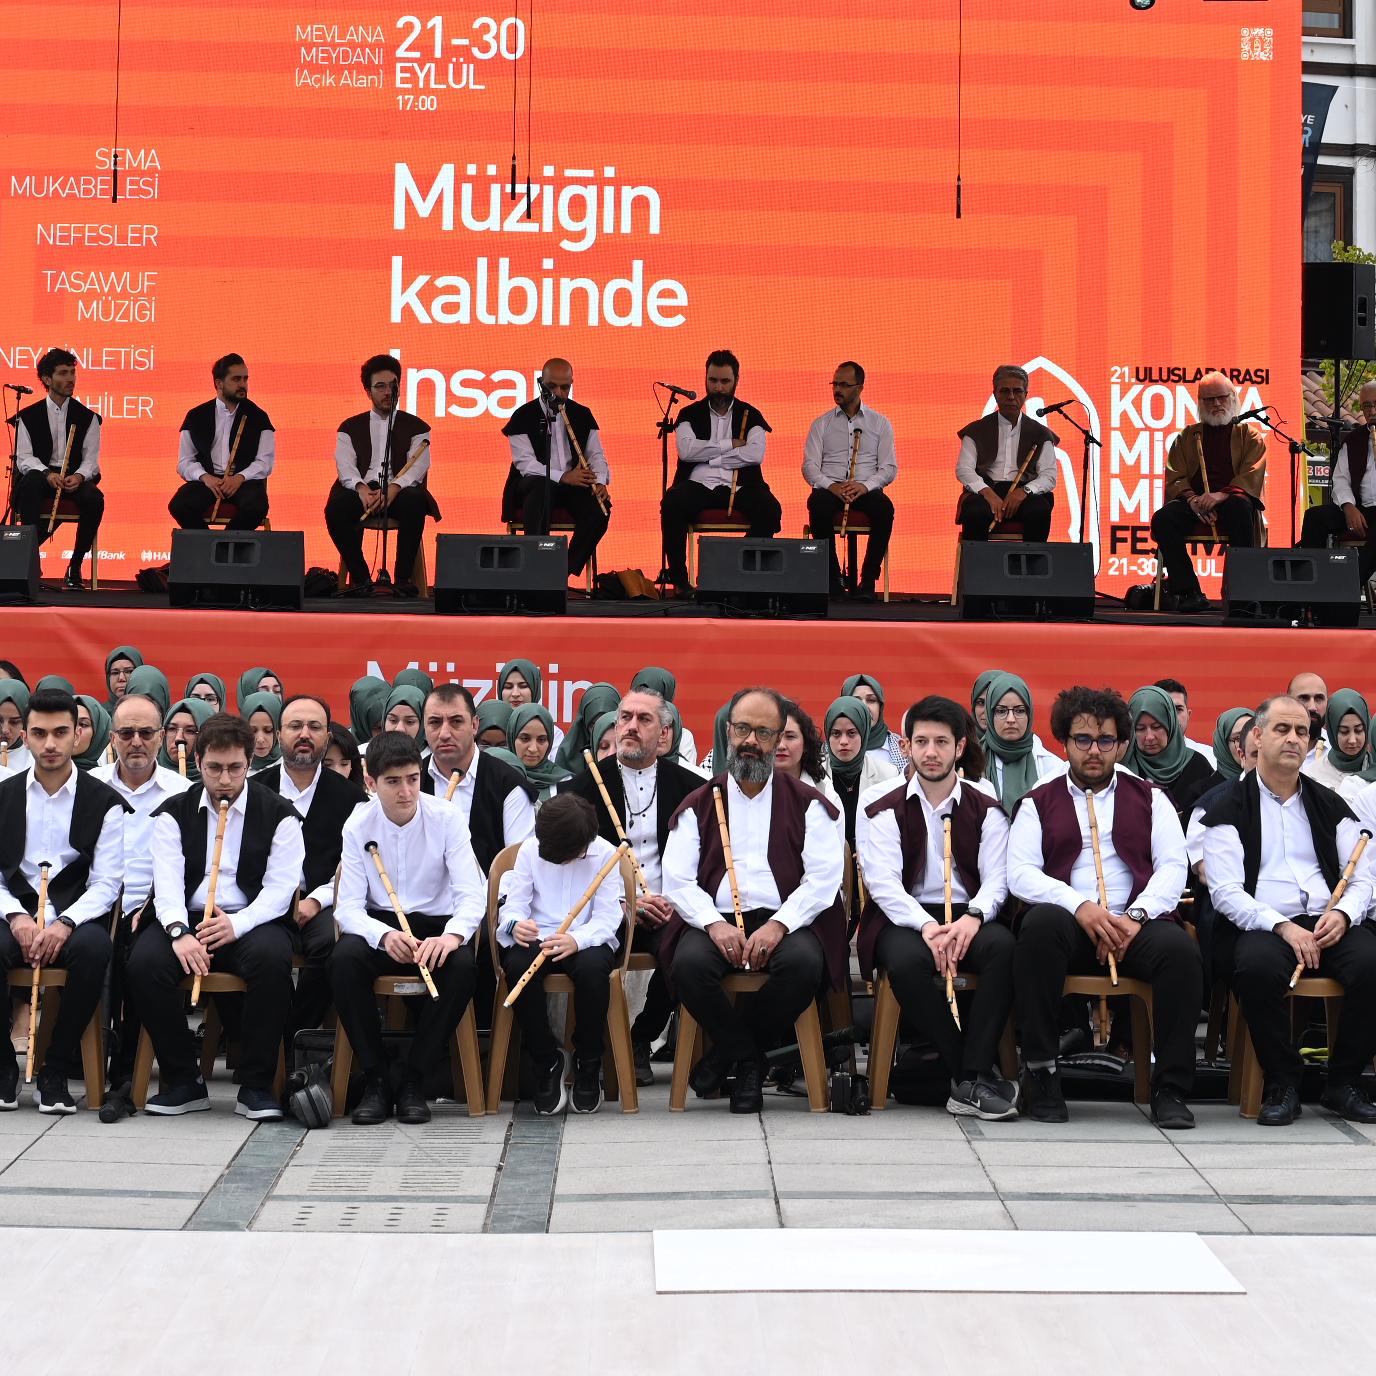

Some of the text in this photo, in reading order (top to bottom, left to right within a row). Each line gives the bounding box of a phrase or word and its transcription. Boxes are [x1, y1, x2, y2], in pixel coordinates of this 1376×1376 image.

[296, 24, 385, 43] MEVLANA
[395, 15, 526, 60] 21-30
[300, 46, 384, 65] MEYDANI
[339, 69, 384, 89] Alan)
[395, 57, 486, 90] EYLÜL
[397, 94, 438, 111] 17:00
[95, 147, 161, 171] SEMA
[393, 162, 661, 252] Müziğin
[36, 223, 159, 247] NEFESLER
[390, 255, 689, 328] kalbinde
[77, 295, 155, 323] MÜZİĞİ
[48, 343, 154, 371] NLETİSİ
[1110, 384, 1271, 431] KONA
